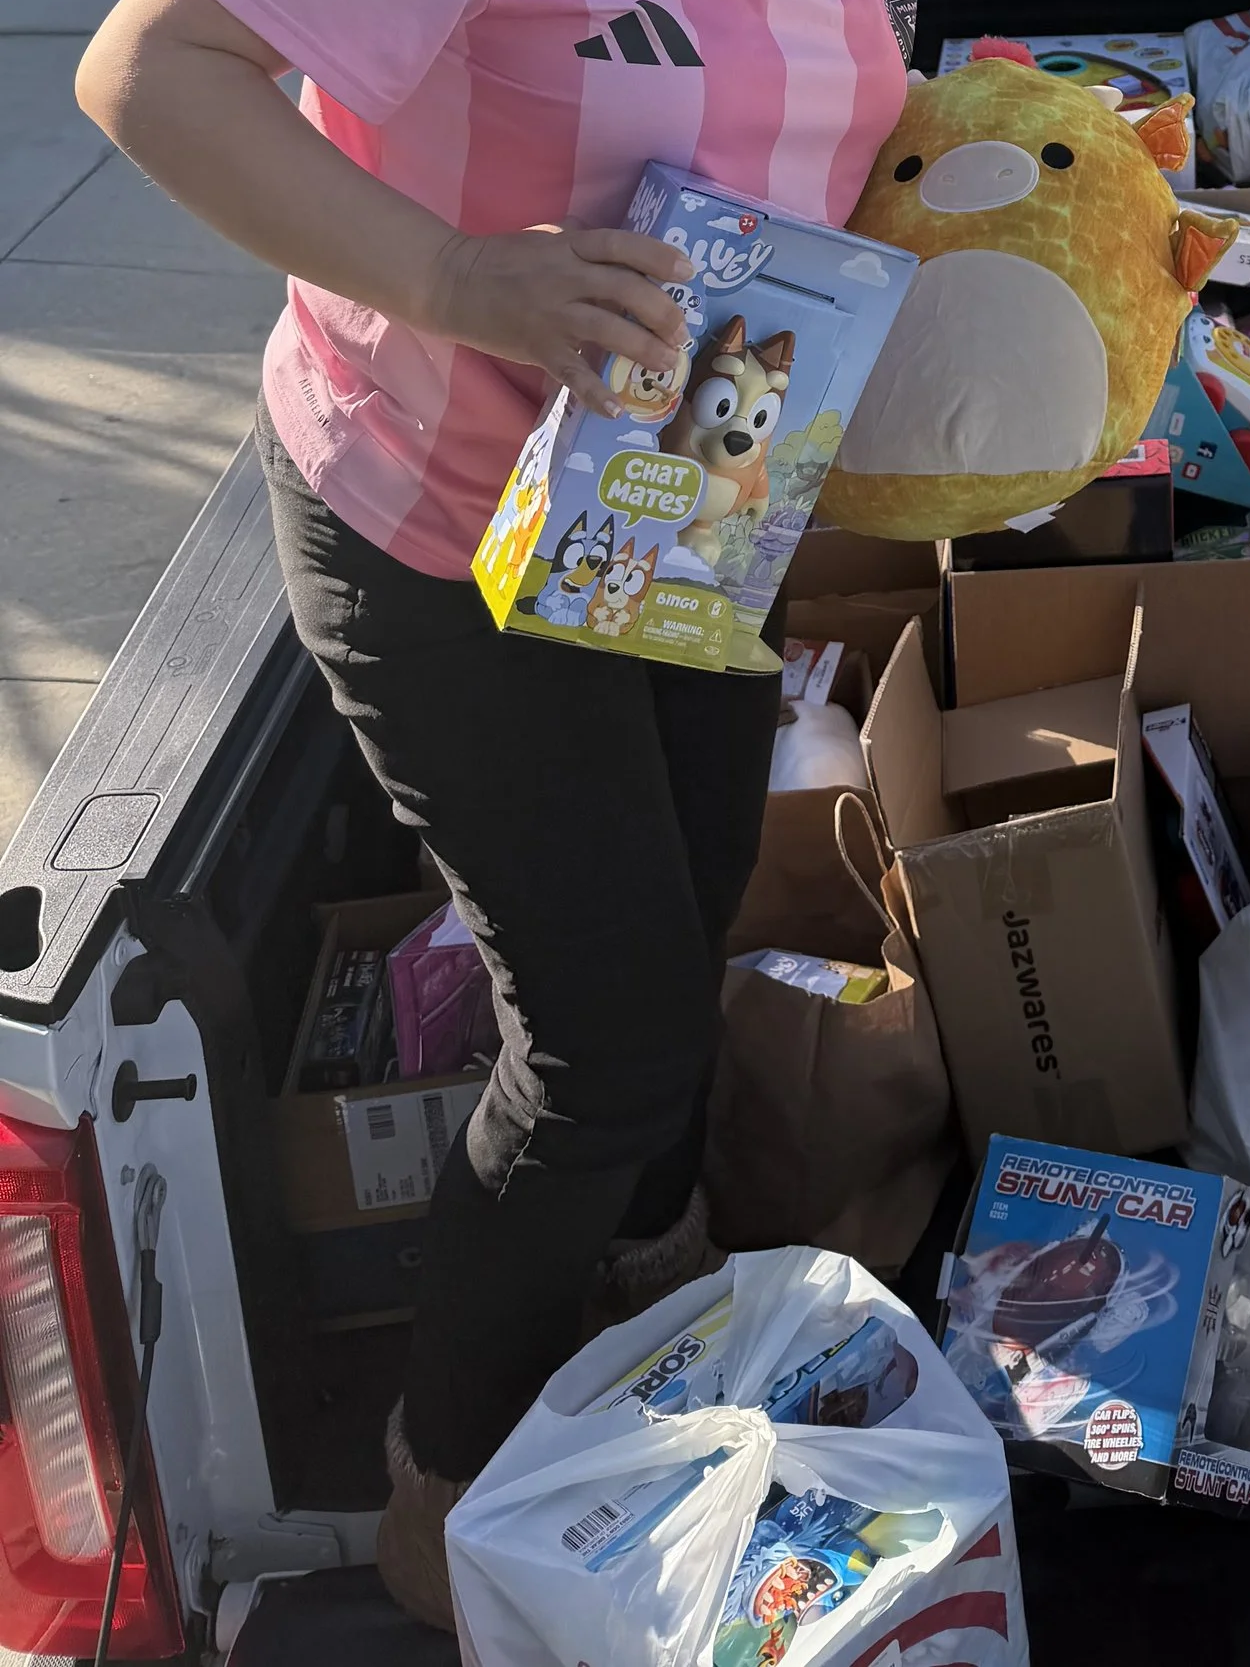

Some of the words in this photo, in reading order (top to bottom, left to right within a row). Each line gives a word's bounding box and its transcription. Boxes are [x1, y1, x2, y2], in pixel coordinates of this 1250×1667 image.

[663, 619, 704, 636] WARNING:
[1001, 1154, 1091, 1183] REMOTE
[1093, 1170, 1196, 1204] CONTROL
[996, 1169, 1110, 1211] STUNT
[1116, 1192, 1195, 1229] CAR
[1094, 1410, 1111, 1420] CAR
[1112, 1408, 1136, 1420] FLIPS,
[1111, 1423, 1137, 1435] SPINS,
[1084, 1438, 1101, 1449] TIRE
[1102, 1436, 1144, 1449] WHEELIES,
[1091, 1451, 1109, 1463] AND
[1110, 1449, 1138, 1462] MORE!
[1179, 1450, 1217, 1473] REMOTE
[1175, 1465, 1225, 1498] STUNT
